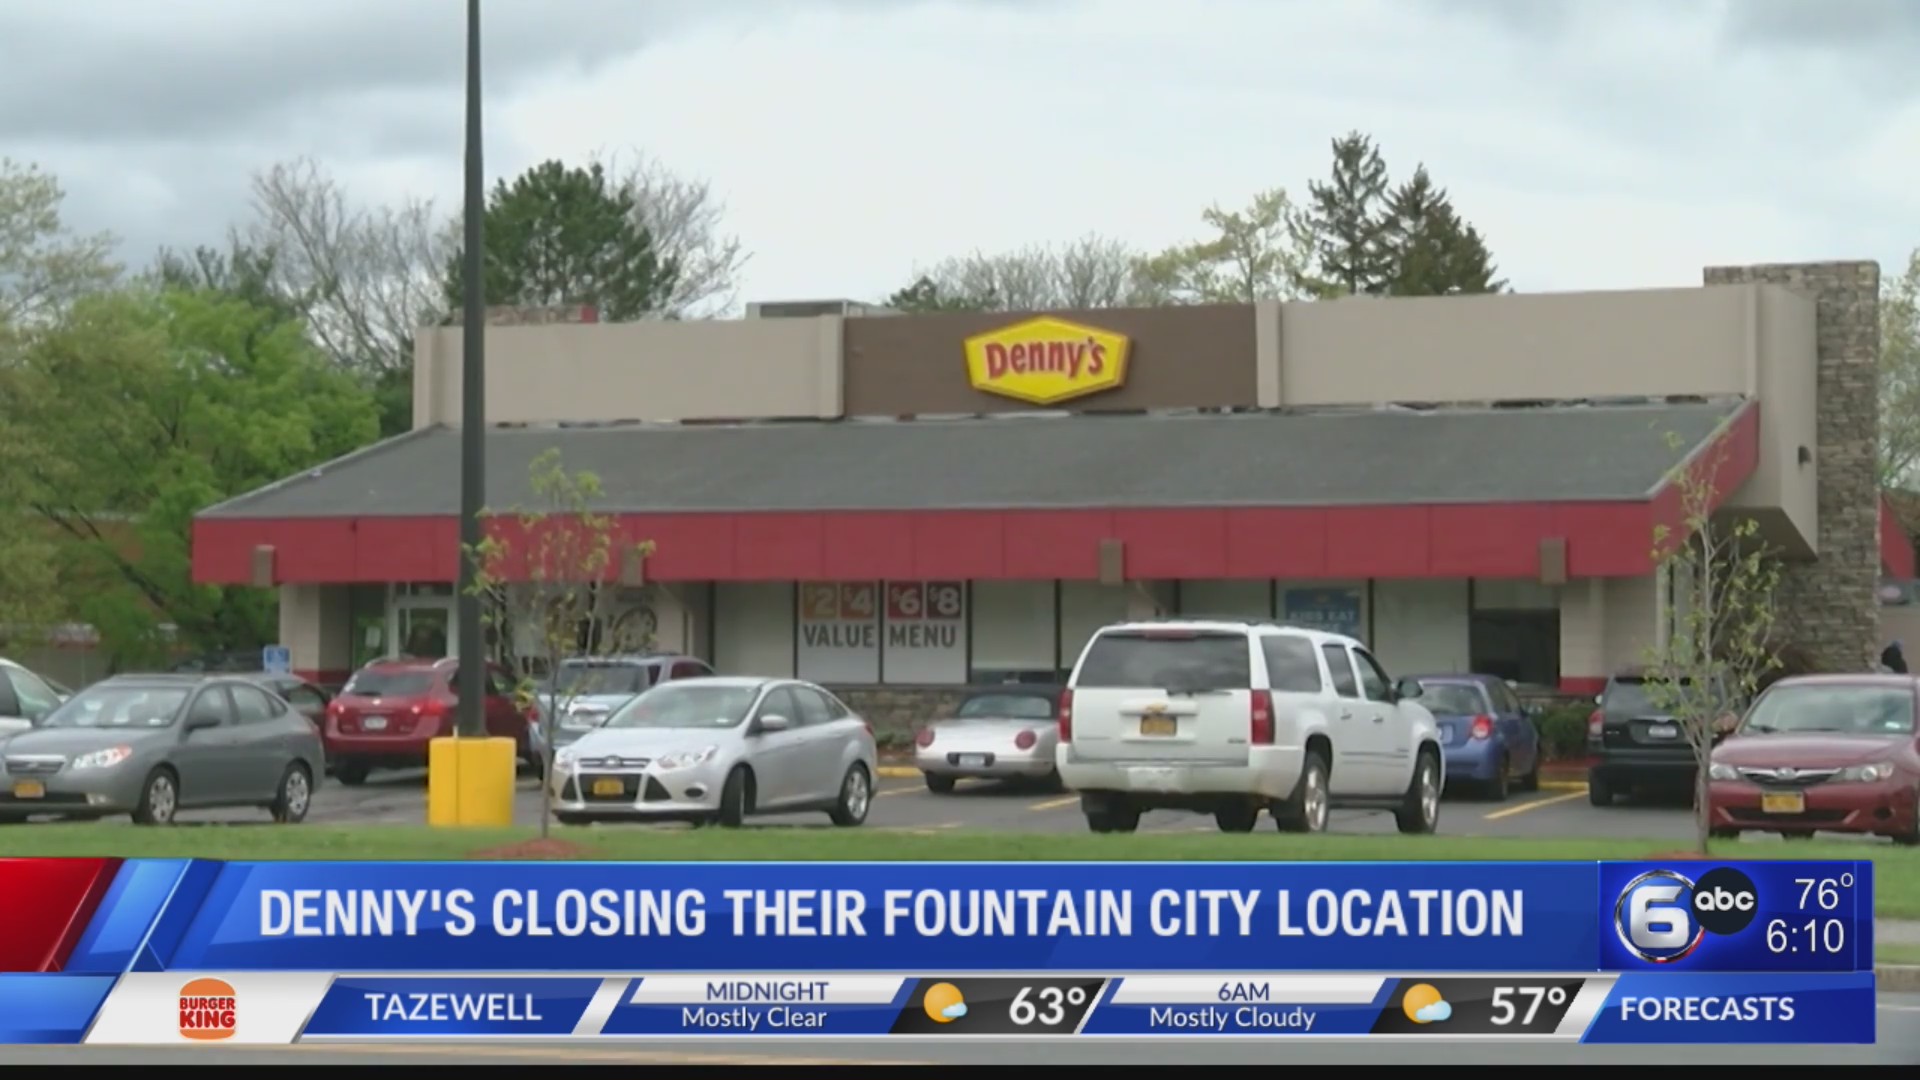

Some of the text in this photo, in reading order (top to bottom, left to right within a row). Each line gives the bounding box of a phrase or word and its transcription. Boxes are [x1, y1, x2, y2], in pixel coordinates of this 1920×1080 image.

[985, 336, 1106, 380] Denny's
[804, 624, 956, 648] VALUE MENU
